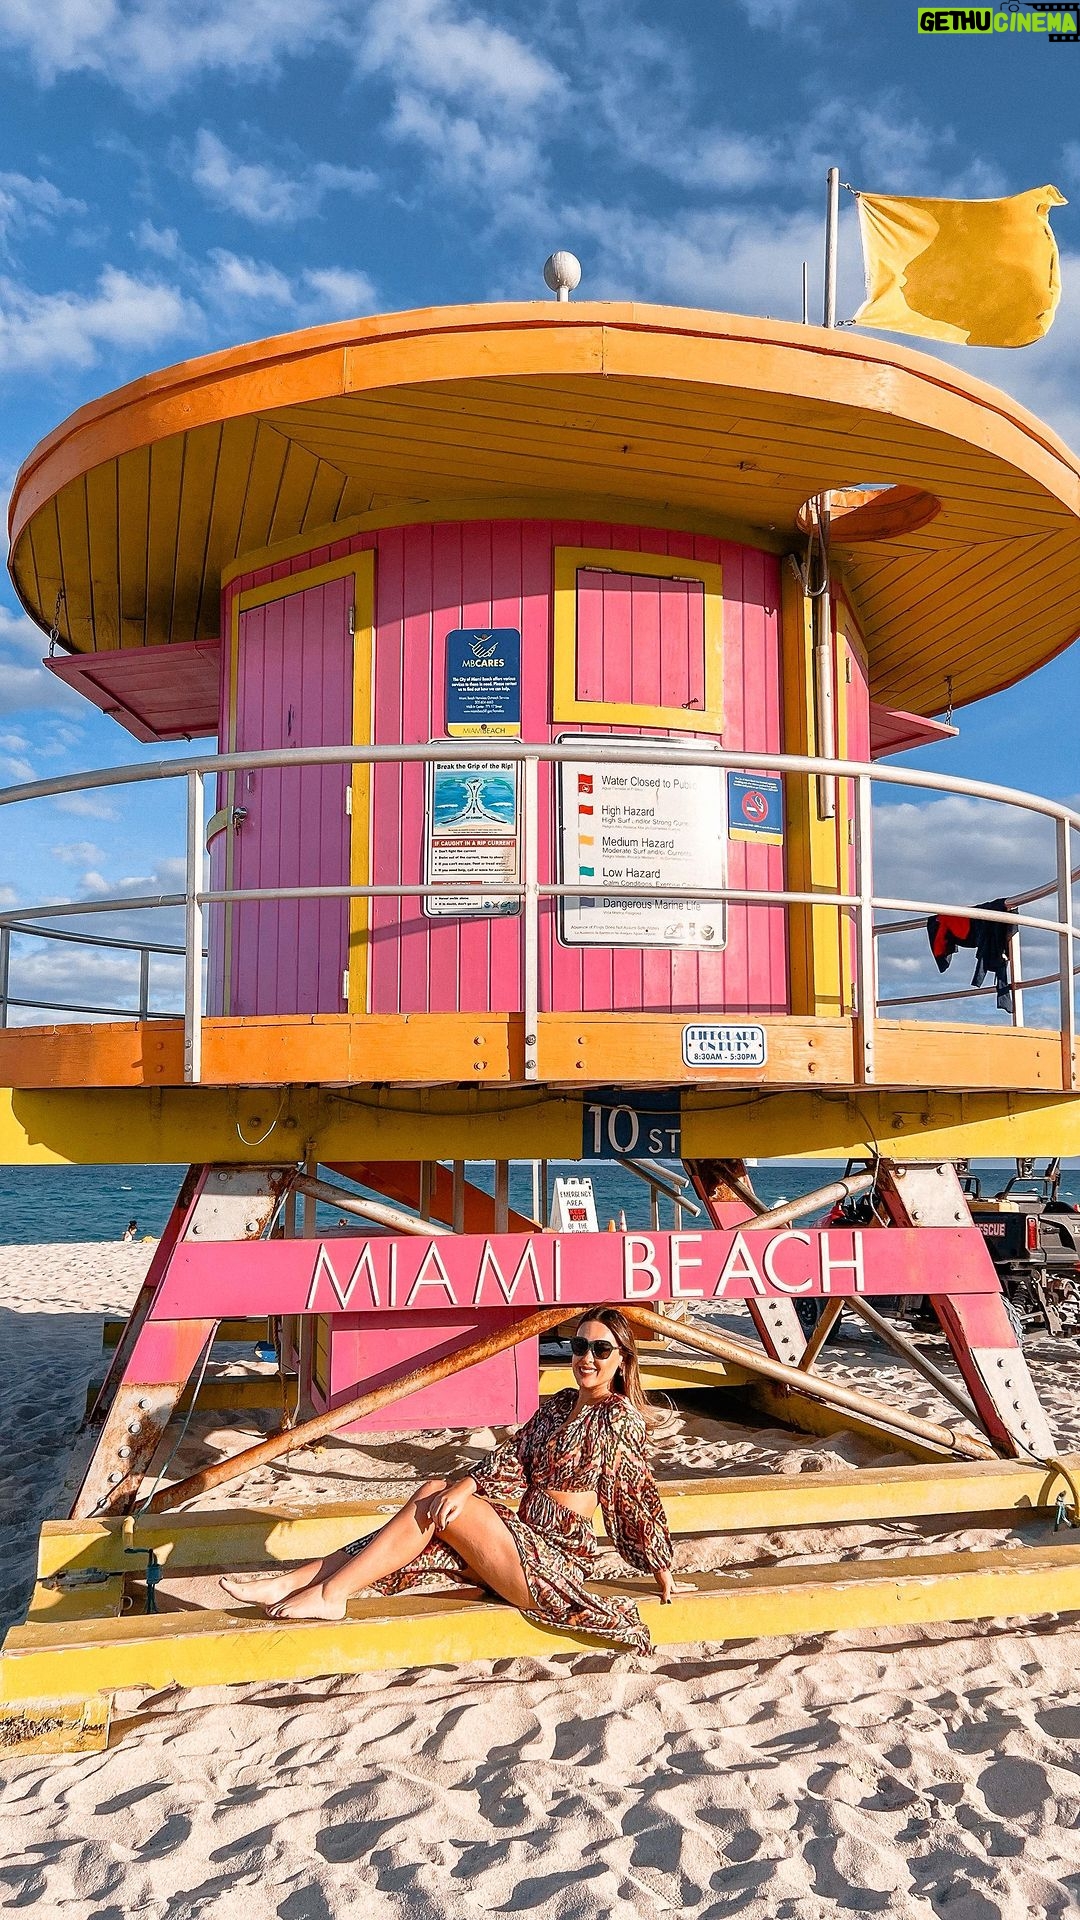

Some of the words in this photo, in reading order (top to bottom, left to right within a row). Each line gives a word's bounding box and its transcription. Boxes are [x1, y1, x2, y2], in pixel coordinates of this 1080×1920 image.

[462, 659, 505, 667] MBCARES
[601, 776, 628, 786] Water
[631, 776, 660, 787] Closed
[663, 780, 671, 788] to
[673, 779, 697, 790] Pubc
[602, 805, 620, 817] High
[623, 806, 655, 817] Hazard
[602, 836, 638, 847] Medium
[641, 838, 674, 848] Hazard
[602, 868, 622, 877] Low
[626, 868, 661, 878] Hazard
[603, 898, 652, 910] Dangerous
[655, 899, 683, 910] Marine
[687, 900, 701, 911] Life
[691, 1031, 758, 1041] LIFEGUARD
[699, 1042, 716, 1051] ON
[719, 1042, 751, 1051] DUTY
[588, 1104, 640, 1153] 10
[648, 1128, 681, 1154] ST
[975, 1223, 1005, 1237] ESCUE
[305, 1238, 562, 1310] MIAMI
[623, 1230, 865, 1300] BEACH
